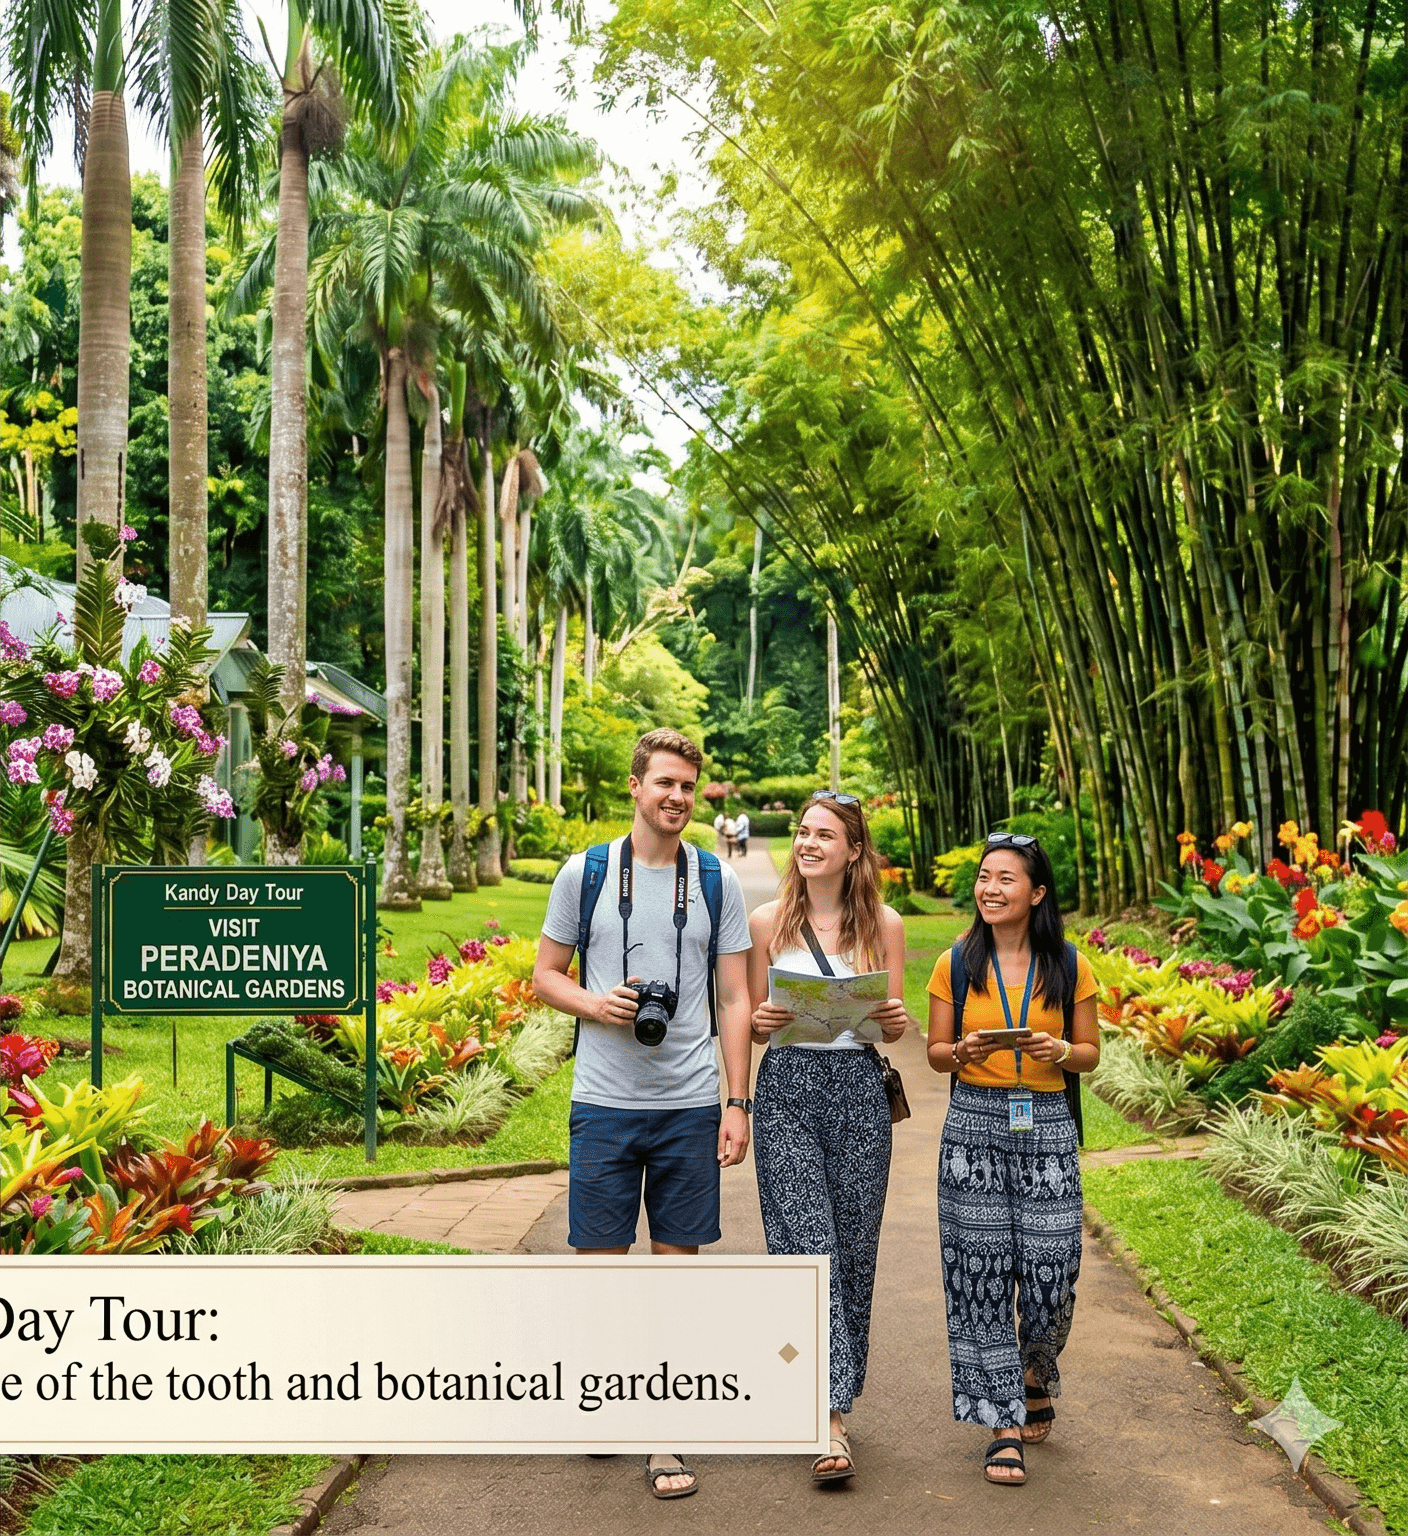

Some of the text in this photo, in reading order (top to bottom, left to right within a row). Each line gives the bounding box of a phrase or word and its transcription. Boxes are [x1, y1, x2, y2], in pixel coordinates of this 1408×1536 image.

[165, 883, 304, 905] Kandy Day Tour
[208, 918, 261, 938] VISIT
[141, 944, 328, 972] PERADENIYA
[123, 978, 345, 999] BOTANICAL GARDENS
